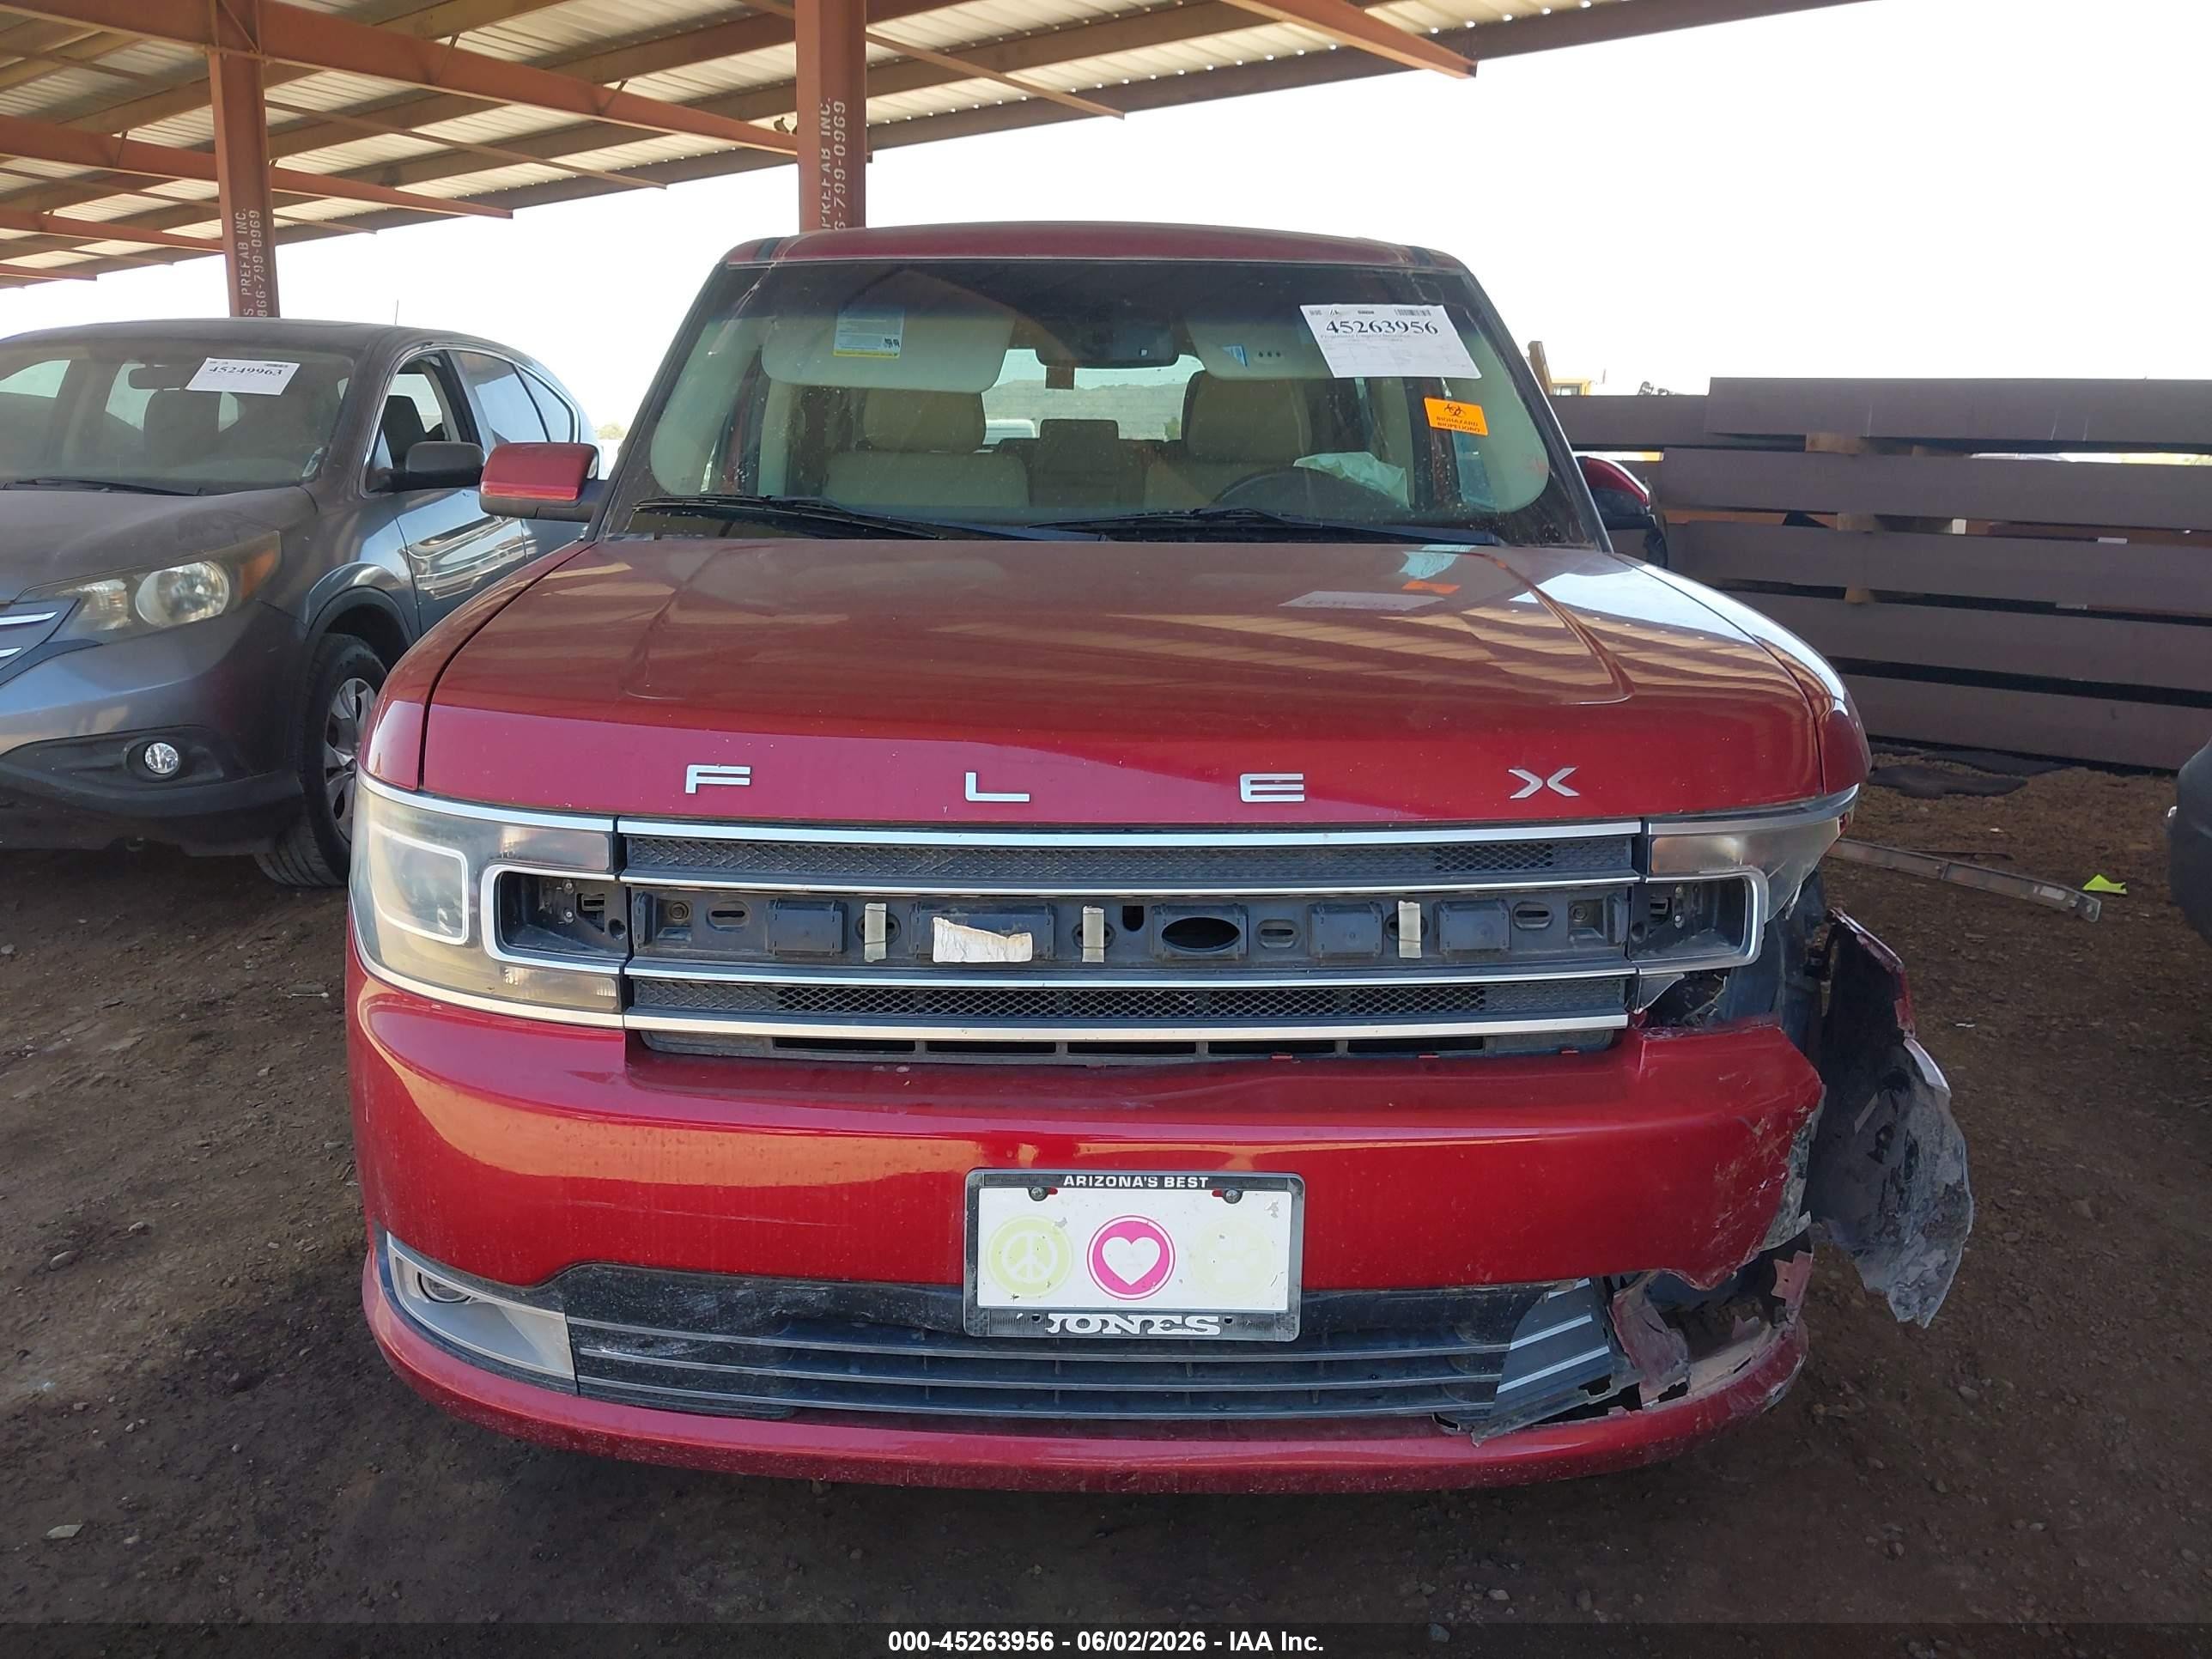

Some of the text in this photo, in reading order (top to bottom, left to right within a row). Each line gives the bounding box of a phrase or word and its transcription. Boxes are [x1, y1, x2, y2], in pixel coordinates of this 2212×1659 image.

[820, 97, 831, 137] INC.
[234, 207, 248, 234] INC.
[237, 241, 252, 295] PREFAB
[1326, 319, 1438, 335] 45263956
[209, 366, 283, 376] 45249963
[1063, 1174, 1209, 1188] ARIZONA'S BEST
[1045, 1312, 1221, 1336] JONES
